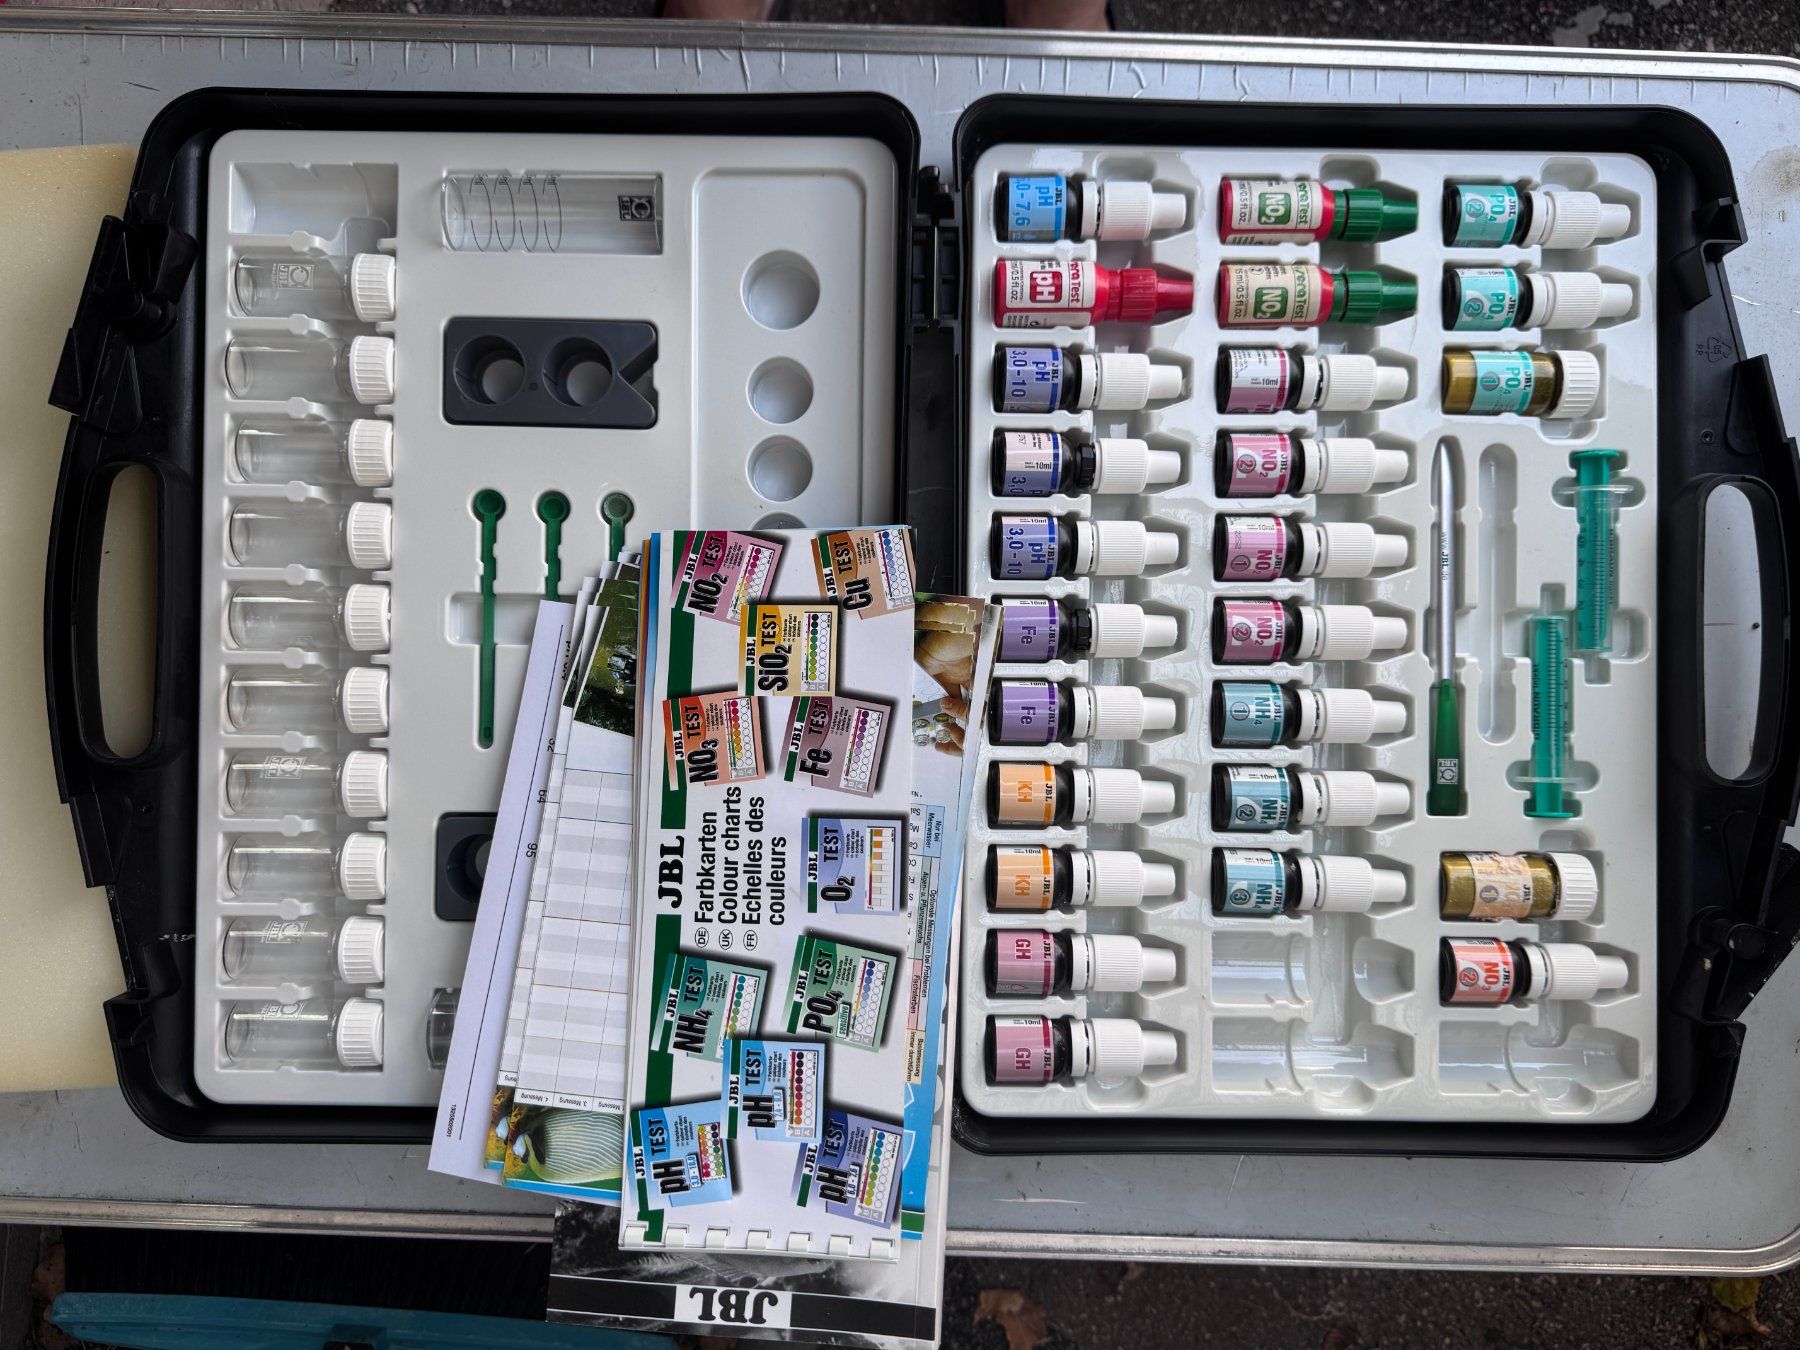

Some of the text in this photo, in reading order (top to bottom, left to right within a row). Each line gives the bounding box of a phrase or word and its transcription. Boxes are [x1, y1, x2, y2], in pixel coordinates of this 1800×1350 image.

[1035, 187, 1054, 206] pH
[1298, 203, 1310, 224] Test
[1034, 273, 1055, 300] pH
[1294, 300, 1306, 319] Test
[1507, 298, 1516, 316] JBL
[1032, 361, 1050, 382] pH
[1524, 371, 1532, 390] JBL
[1280, 454, 1288, 473] JBL
[834, 542, 852, 574] TEST
[1029, 543, 1046, 564] pH
[1047, 544, 1055, 564] JBL
[1274, 554, 1282, 571] JBL
[685, 556, 698, 579] JBL
[688, 535, 728, 614] NO2 TEST
[825, 569, 836, 594] JBL
[842, 578, 872, 610] Cu
[1021, 626, 1036, 644] Fe
[1048, 626, 1056, 644] JBL
[747, 640, 756, 664] JBL
[758, 613, 792, 691] SiO2 TEST
[1021, 706, 1036, 724] Fe
[674, 732, 684, 758] JBL
[685, 706, 718, 783] NO3 TEST
[791, 725, 803, 750] JBL
[799, 701, 832, 776] Fe TEST
[1018, 781, 1032, 802] KH
[1279, 804, 1288, 821] JBL
[926, 812, 934, 848] Meerwasser
[526, 842, 538, 858] 95
[658, 836, 684, 908] JBL
[694, 812, 717, 944] DE Farbkarten
[718, 786, 741, 947] UK Colour charts
[742, 796, 764, 947] FR Echelles des
[808, 854, 818, 880] JBL
[820, 827, 856, 902] O2 TEST
[766, 836, 786, 926] couleurs
[921, 872, 929, 890] Algen-
[1015, 874, 1030, 896] KH
[929, 890, 937, 918] Optionale
[1274, 890, 1282, 906] JBL
[916, 899, 927, 944] Pflanzenwuchs
[925, 920, 934, 954] Messungen
[1016, 939, 1031, 960] GH
[796, 972, 808, 999] JBL
[922, 966, 930, 998] Problemen
[1502, 968, 1510, 986] JBL
[666, 990, 680, 1018] JBL
[802, 949, 843, 1034] PO4 TEST
[910, 974, 920, 1014] Fischsterben
[672, 966, 714, 1054] NH4 TEST
[838, 1006, 849, 1034] sensitive
[914, 1038, 924, 1076] Basismessung
[1016, 1048, 1031, 1070] GH
[520, 1093, 543, 1102] Messung
[560, 1097, 582, 1106] Messung
[729, 1077, 739, 1104] JBL
[742, 1049, 776, 1128] pH TEST
[634, 1149, 645, 1176] JBL
[648, 1119, 690, 1194] pH TEST
[804, 1145, 818, 1172] JBL
[816, 1119, 848, 1204] pH TEST
[689, 1287, 778, 1324] JBL
